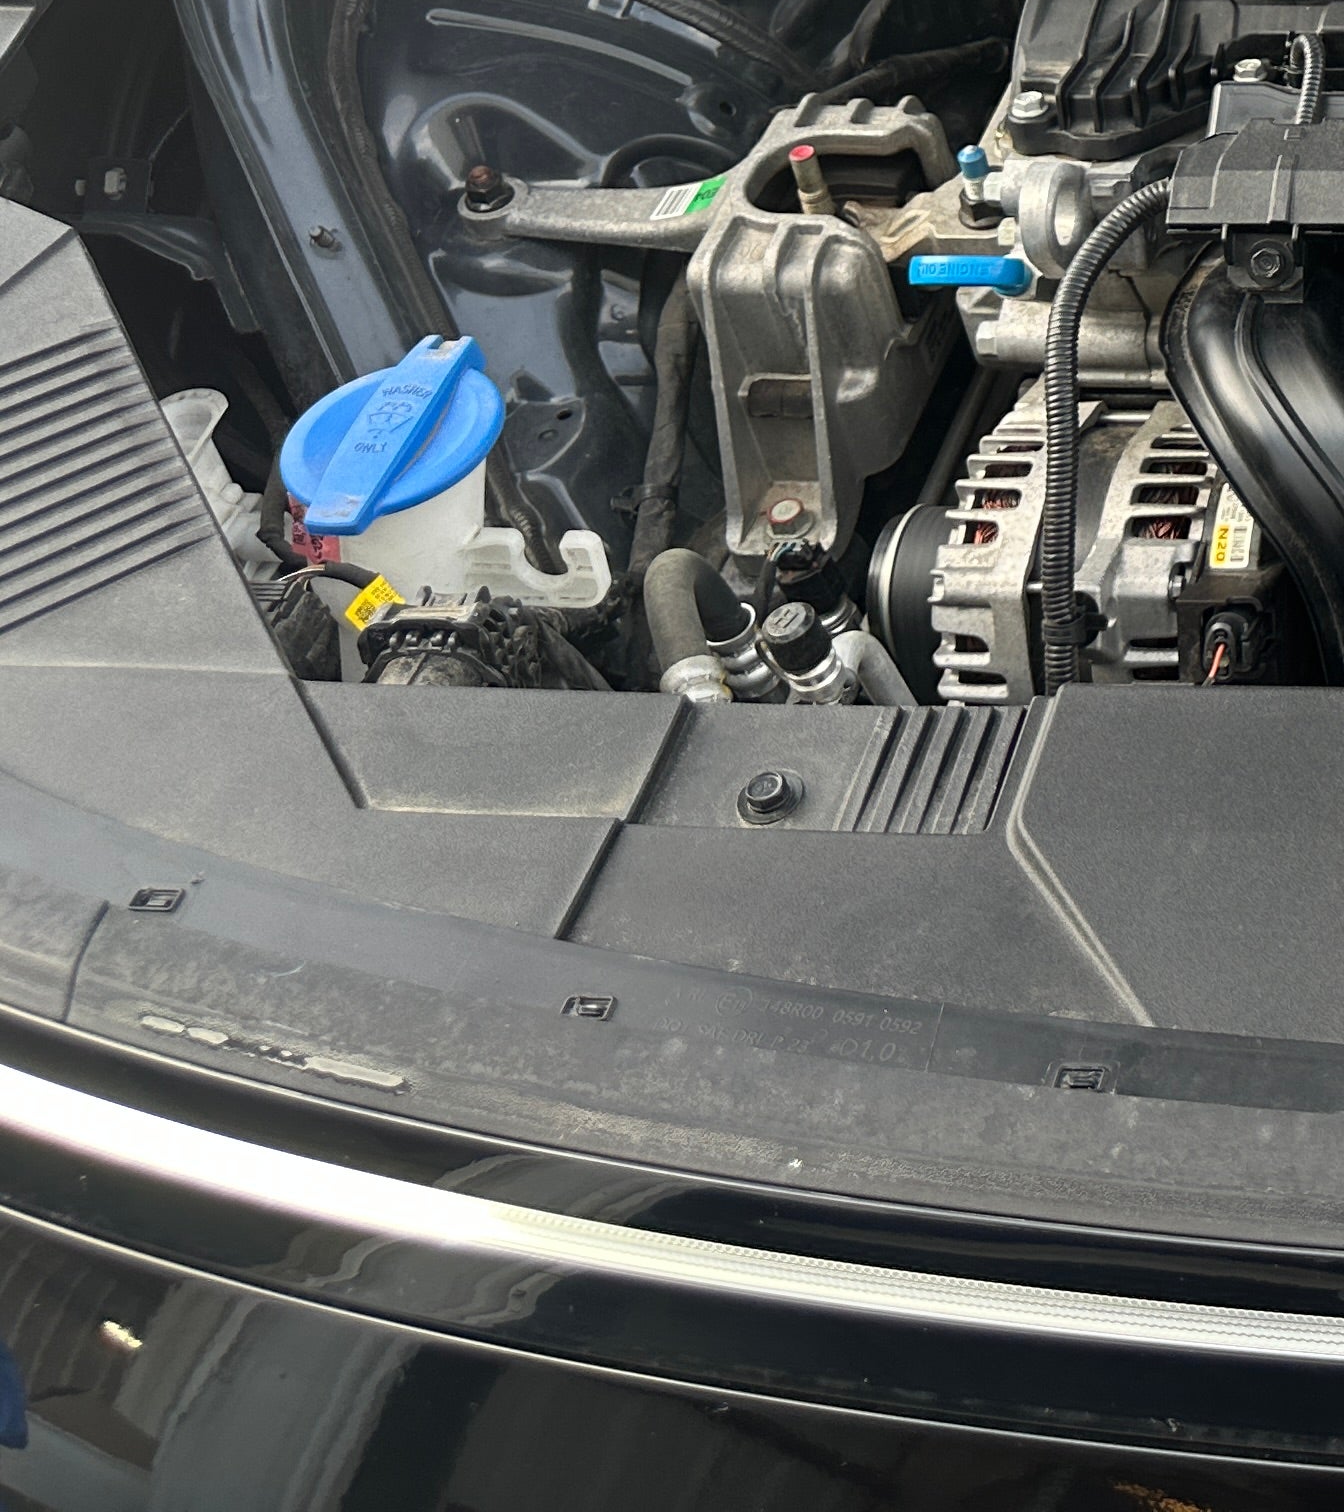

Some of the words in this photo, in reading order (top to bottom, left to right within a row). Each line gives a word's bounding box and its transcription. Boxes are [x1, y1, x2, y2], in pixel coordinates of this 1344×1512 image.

[938, 262, 991, 277] ENGINE
[382, 383, 434, 400] WASHER
[354, 441, 388, 454] ONLY
